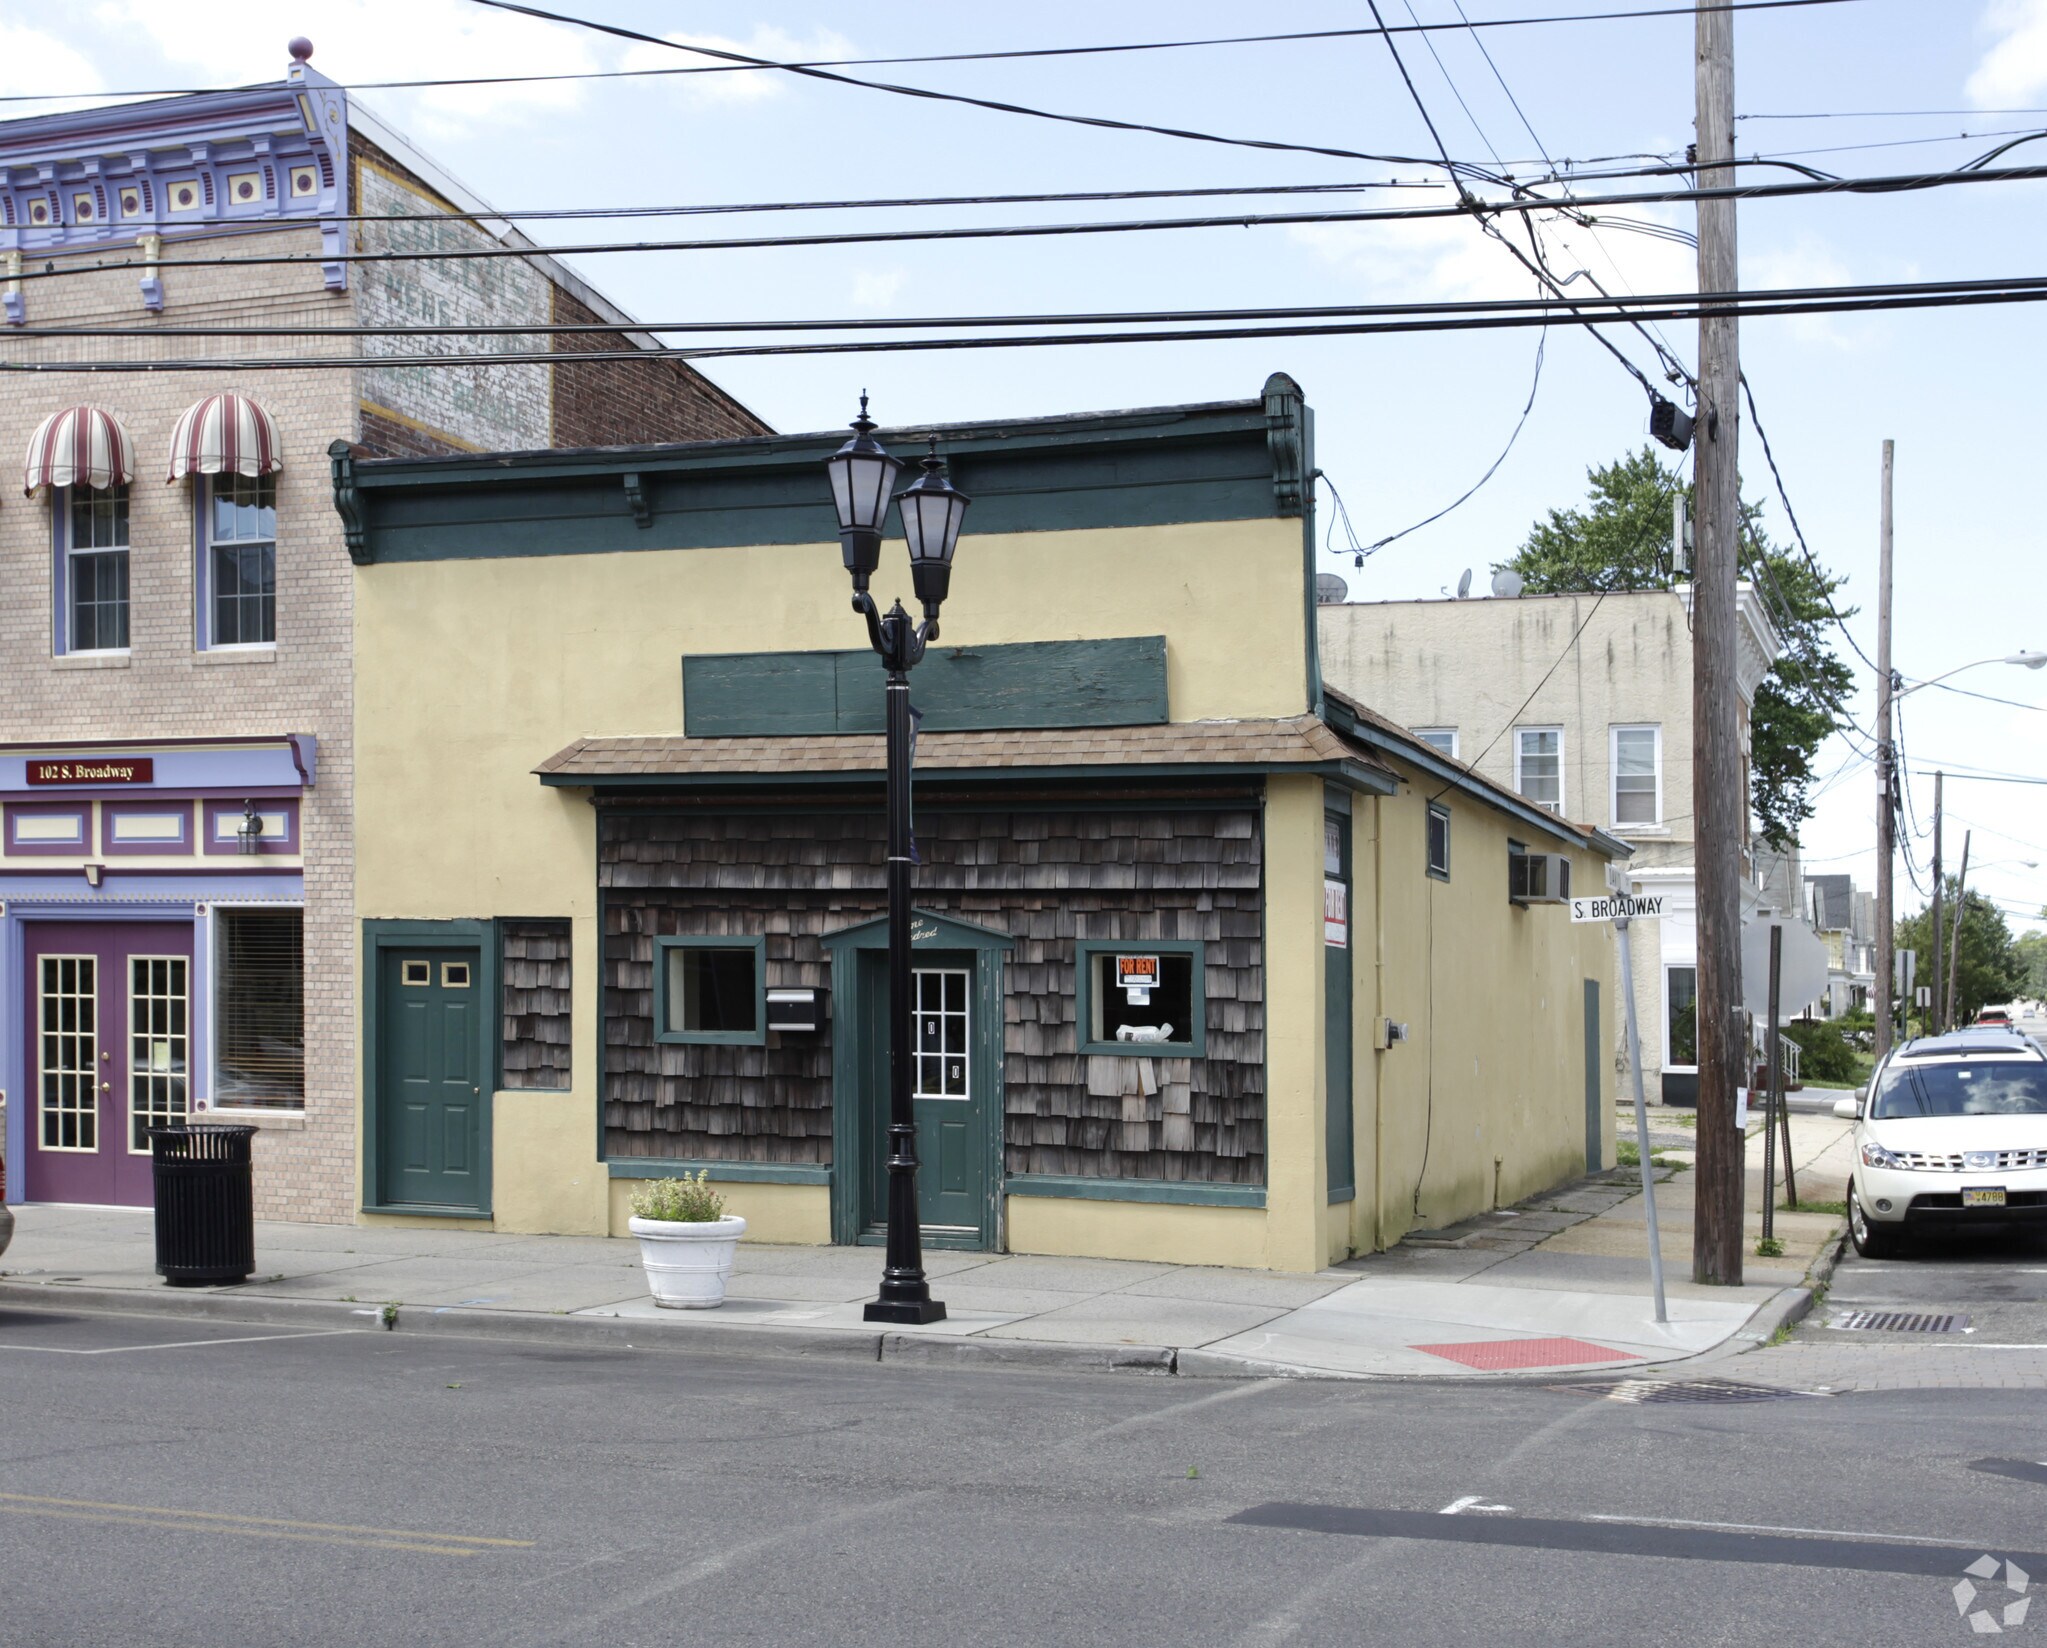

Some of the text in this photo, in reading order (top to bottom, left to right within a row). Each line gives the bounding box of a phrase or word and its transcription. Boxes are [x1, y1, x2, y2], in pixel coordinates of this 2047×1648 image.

[39, 763, 135, 781] 102 S. Broadway
[1591, 897, 1663, 918] BROADWAY
[911, 919, 924, 930] ne
[911, 926, 938, 942] dred
[1120, 959, 1155, 974] FOR RENT
